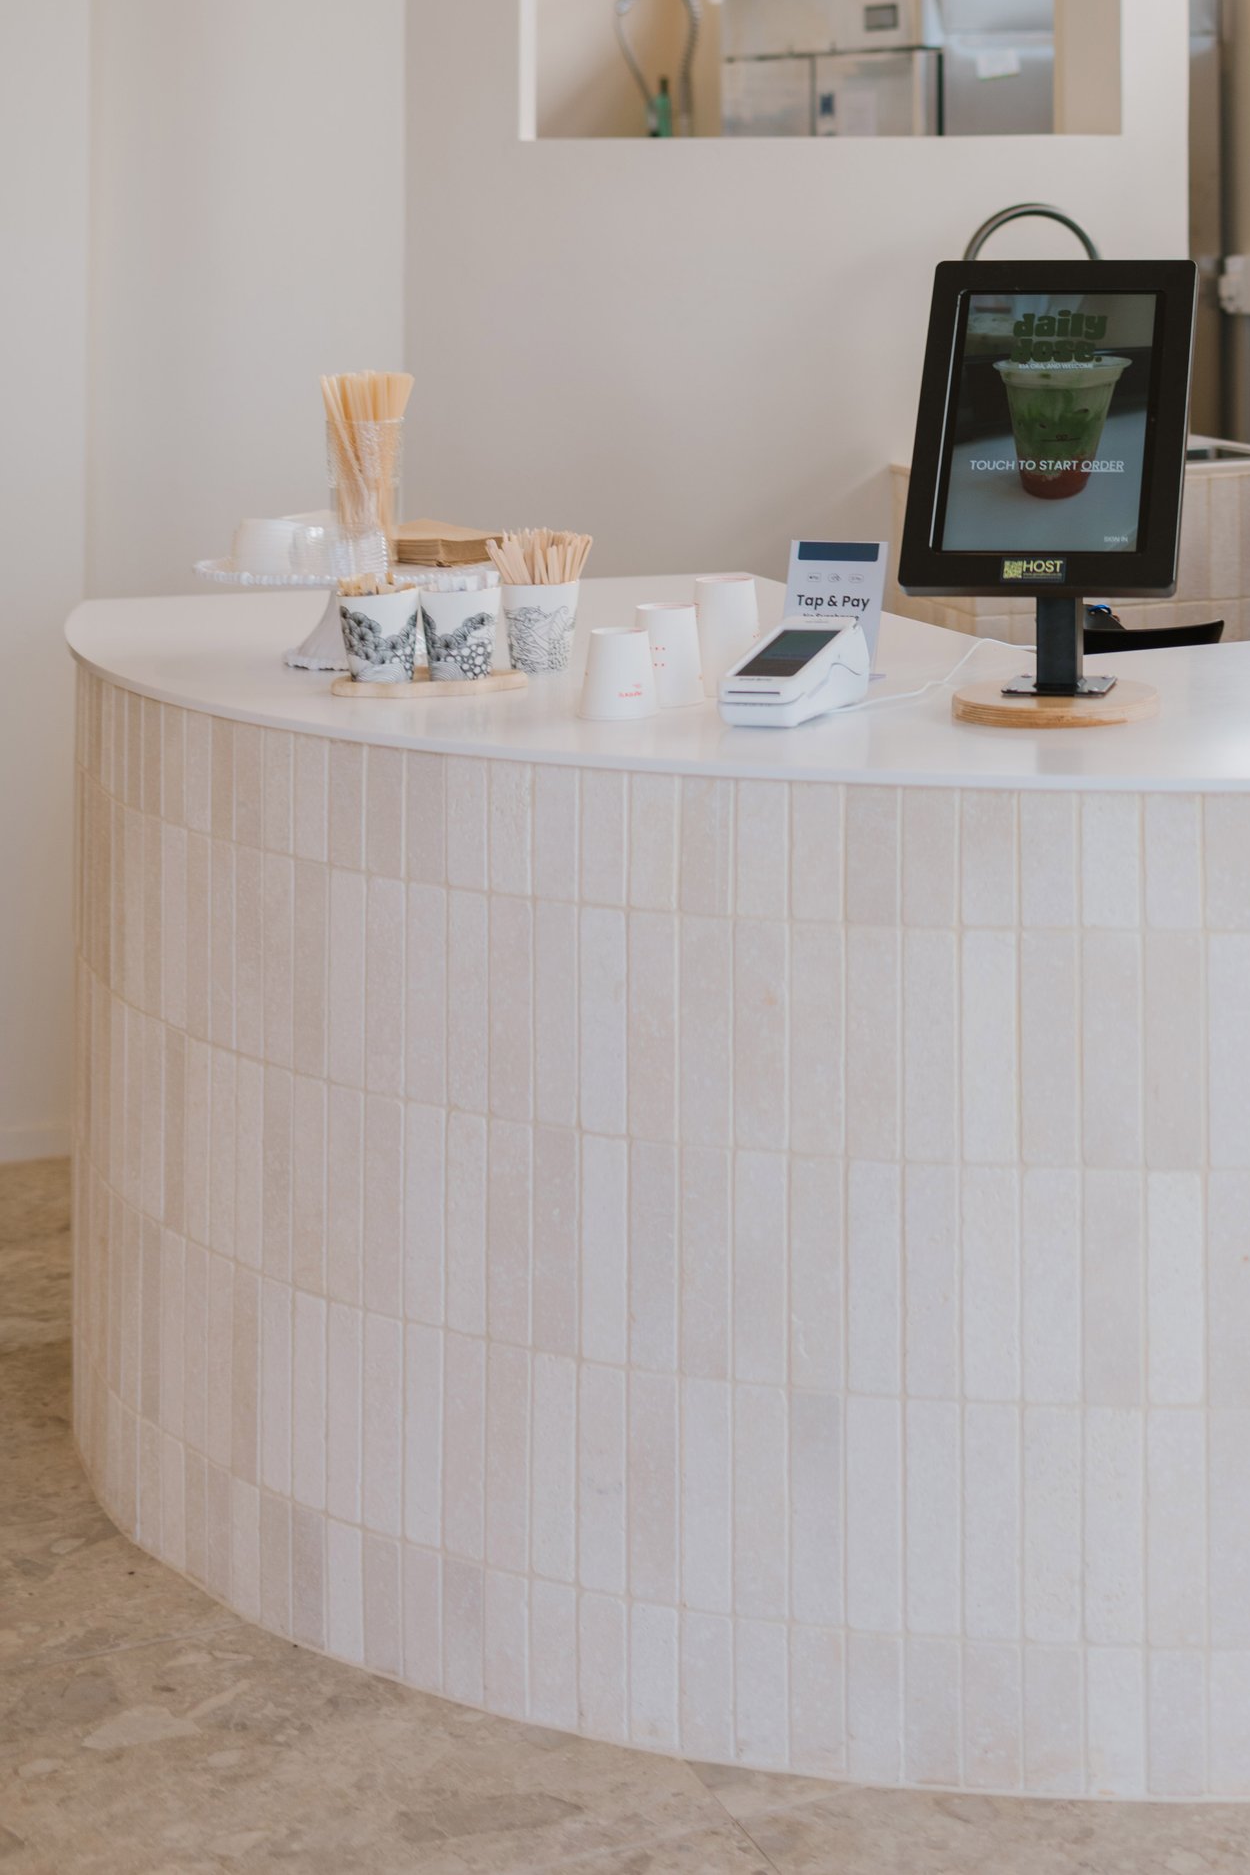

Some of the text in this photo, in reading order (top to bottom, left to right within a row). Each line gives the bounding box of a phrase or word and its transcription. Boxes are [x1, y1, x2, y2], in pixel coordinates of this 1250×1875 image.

[1013, 309, 1108, 340] daily
[970, 460, 1125, 472] TOUCH TO START ORDER
[1022, 560, 1063, 573] HOST
[796, 594, 870, 612] Tap & Pay
